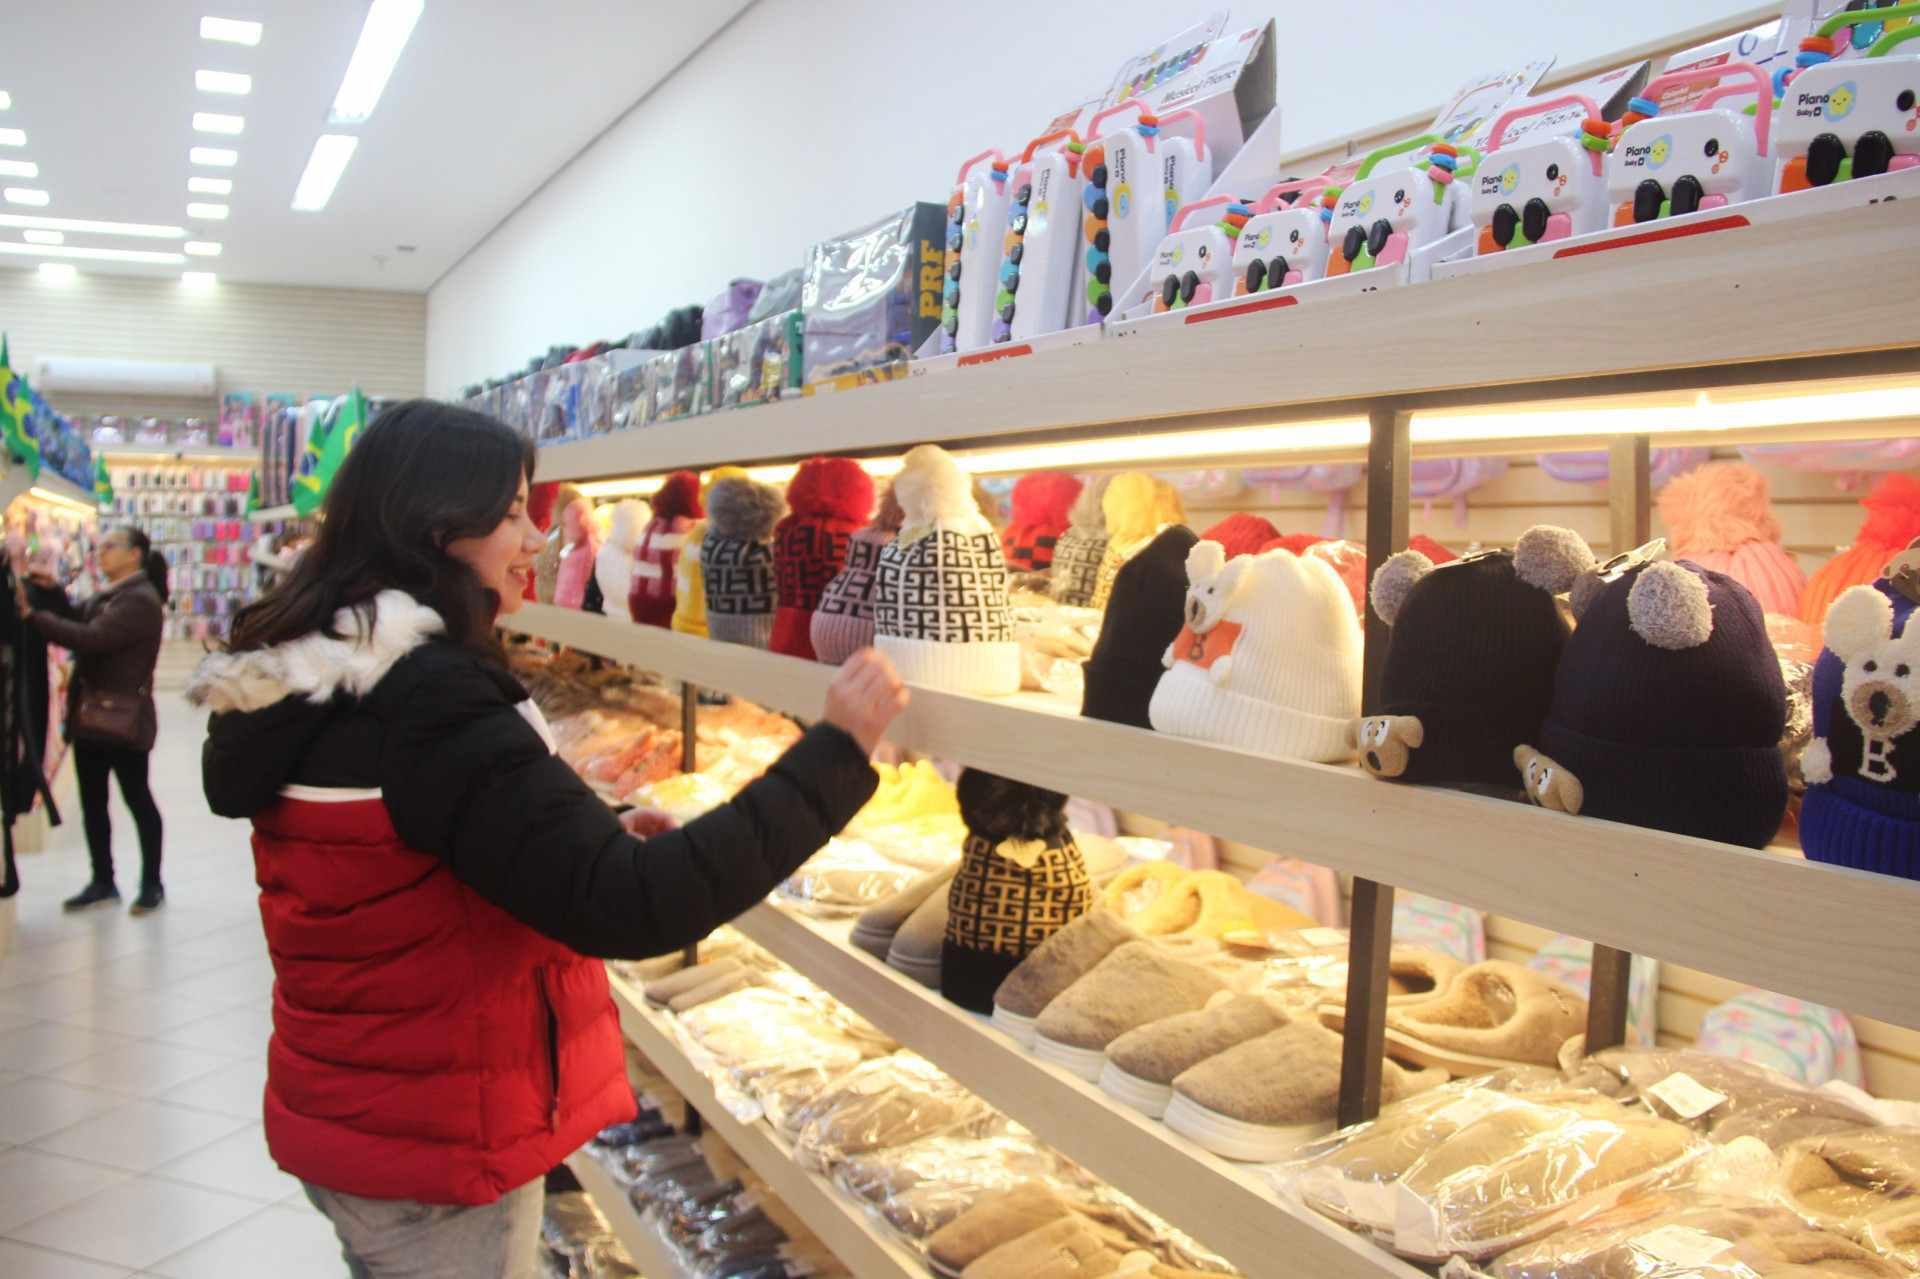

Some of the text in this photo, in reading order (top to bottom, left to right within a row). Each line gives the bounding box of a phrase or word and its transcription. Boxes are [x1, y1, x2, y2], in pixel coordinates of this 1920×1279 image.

[1798, 92, 1830, 105] Piano
[1625, 145, 1651, 157] Piano
[1481, 174, 1503, 186] Piano
[920, 239, 945, 320] PRF
[1857, 733, 1898, 782] B
